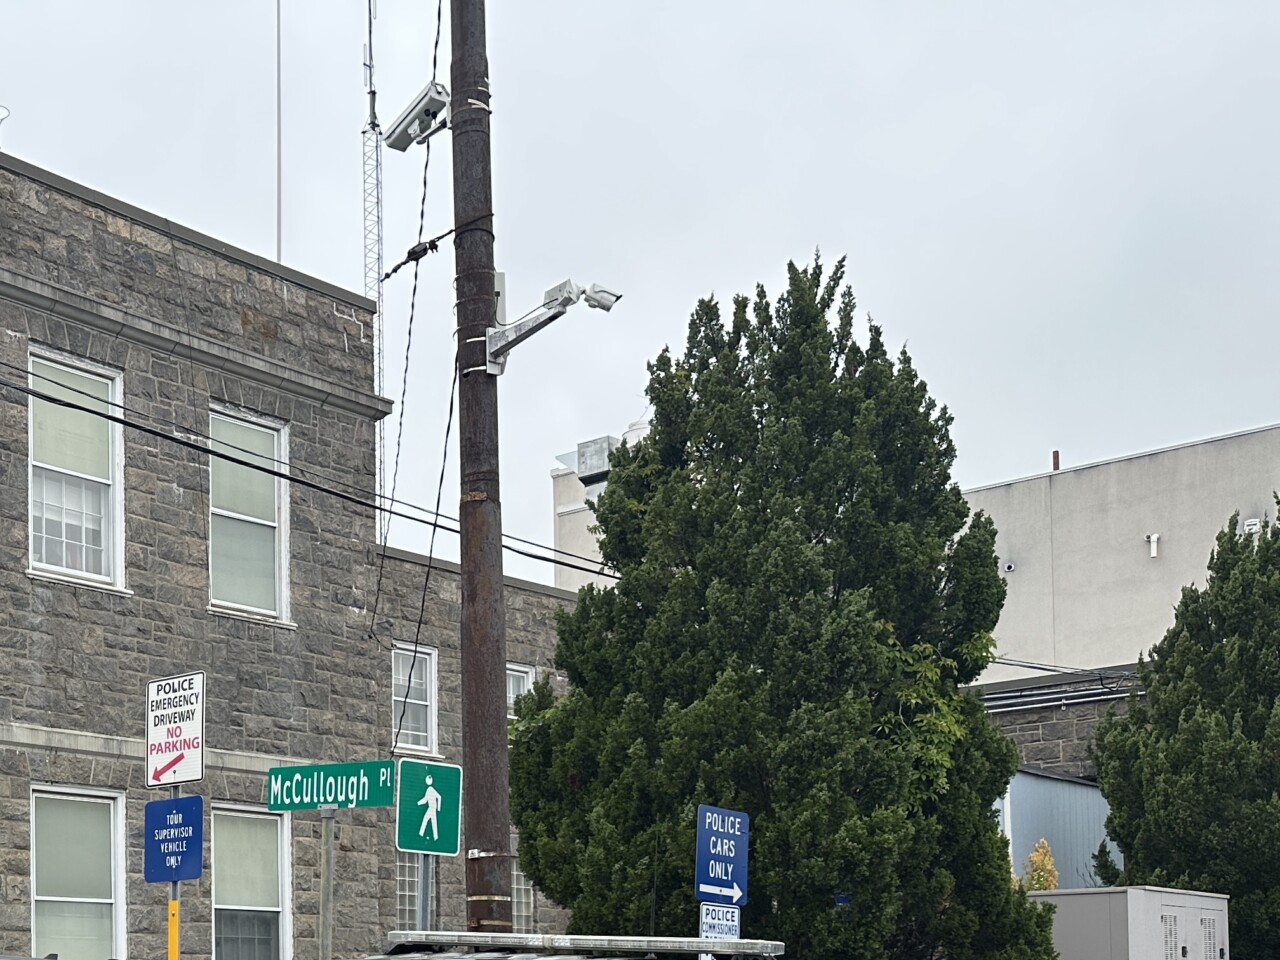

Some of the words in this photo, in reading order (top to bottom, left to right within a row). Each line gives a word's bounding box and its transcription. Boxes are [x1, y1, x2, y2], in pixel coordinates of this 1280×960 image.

[156, 678, 194, 696] POLICE
[150, 692, 200, 712] EMERGENCY
[154, 709, 196, 727] DRIVEWAY
[167, 726, 182, 739] NO
[150, 737, 200, 755] PARKING
[270, 769, 369, 808] McCullough
[380, 767, 391, 787] Pl
[167, 814, 182, 825] TOUR
[706, 812, 741, 835] POLICE
[154, 827, 193, 840] SUPERVISOR
[160, 841, 187, 853] VEHICLE
[710, 836, 735, 857] CARS
[166, 855, 182, 867] ONLY
[709, 860, 733, 880] ONLY
[705, 908, 736, 922] POLICE
[702, 922, 738, 935] COMMISSIONER
